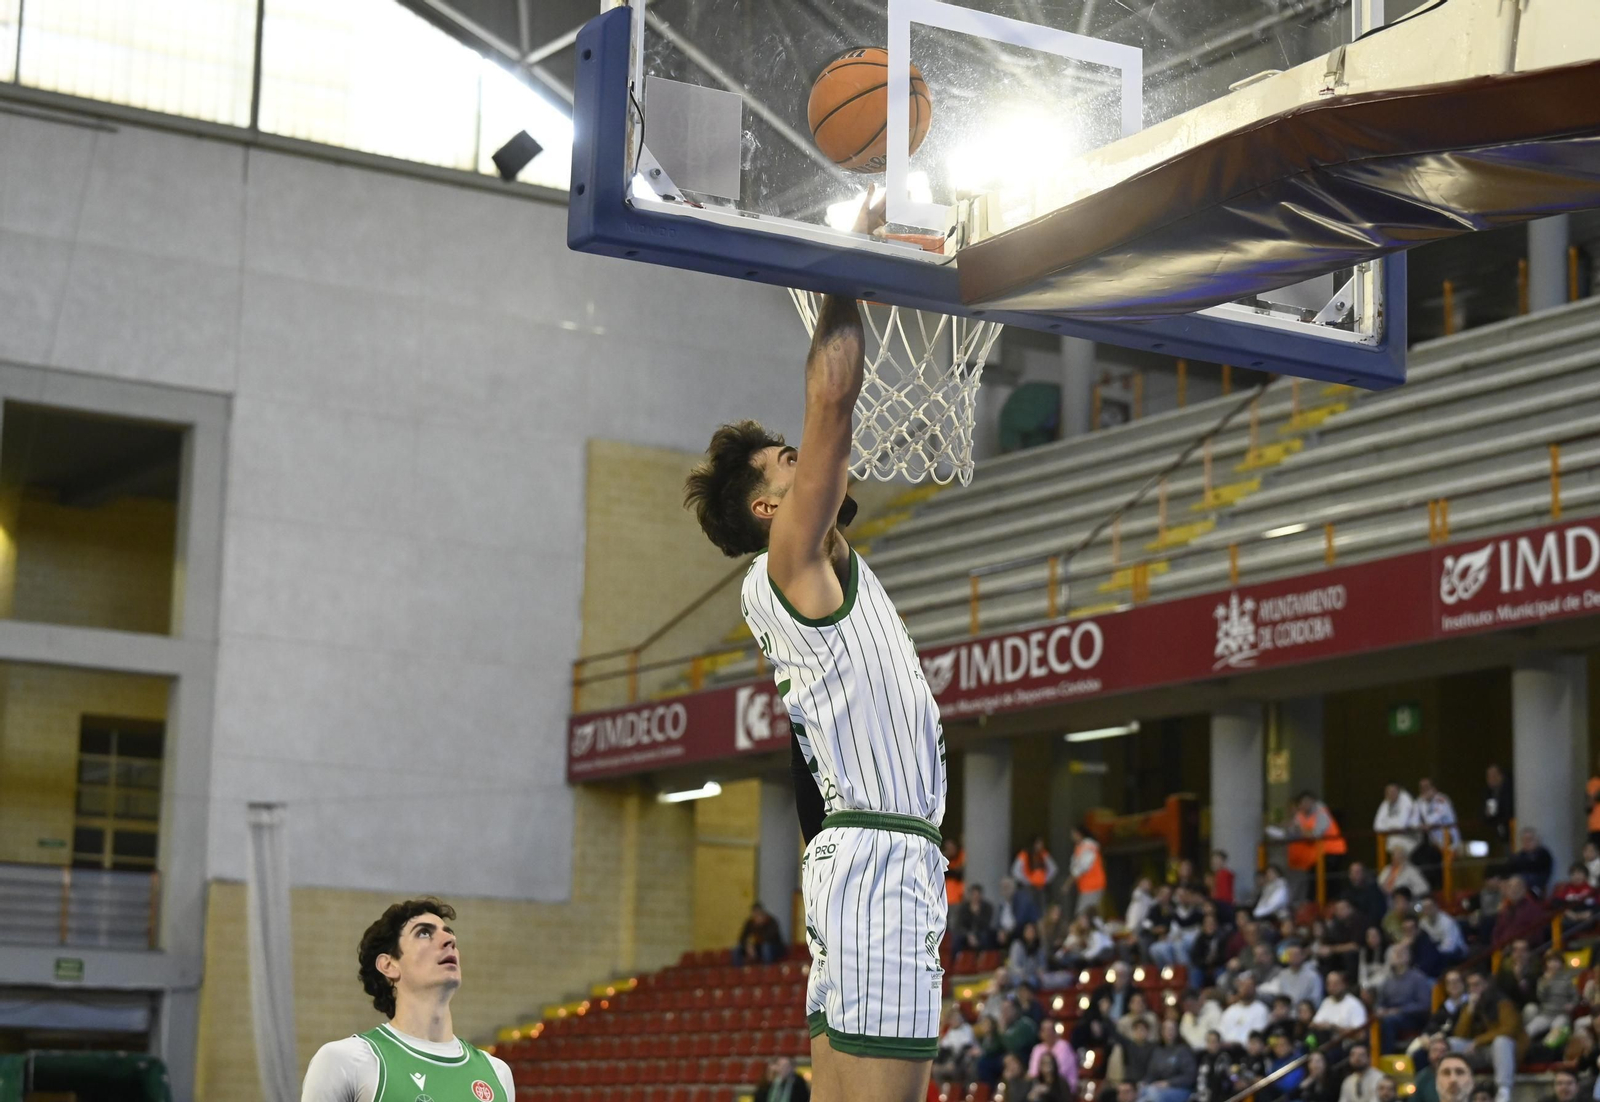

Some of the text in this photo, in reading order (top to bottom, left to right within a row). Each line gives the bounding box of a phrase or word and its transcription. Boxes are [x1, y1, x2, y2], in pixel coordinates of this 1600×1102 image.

[1500, 526, 1600, 593] IMD
[1257, 584, 1347, 622] AYUNTAMIENTO
[1442, 610, 1493, 631] Instituto
[1496, 597, 1560, 620] Municipal
[1563, 594, 1581, 611] de
[959, 621, 1104, 691] IMDECO
[1257, 625, 1274, 650] DE
[595, 703, 687, 752] IMDECO
